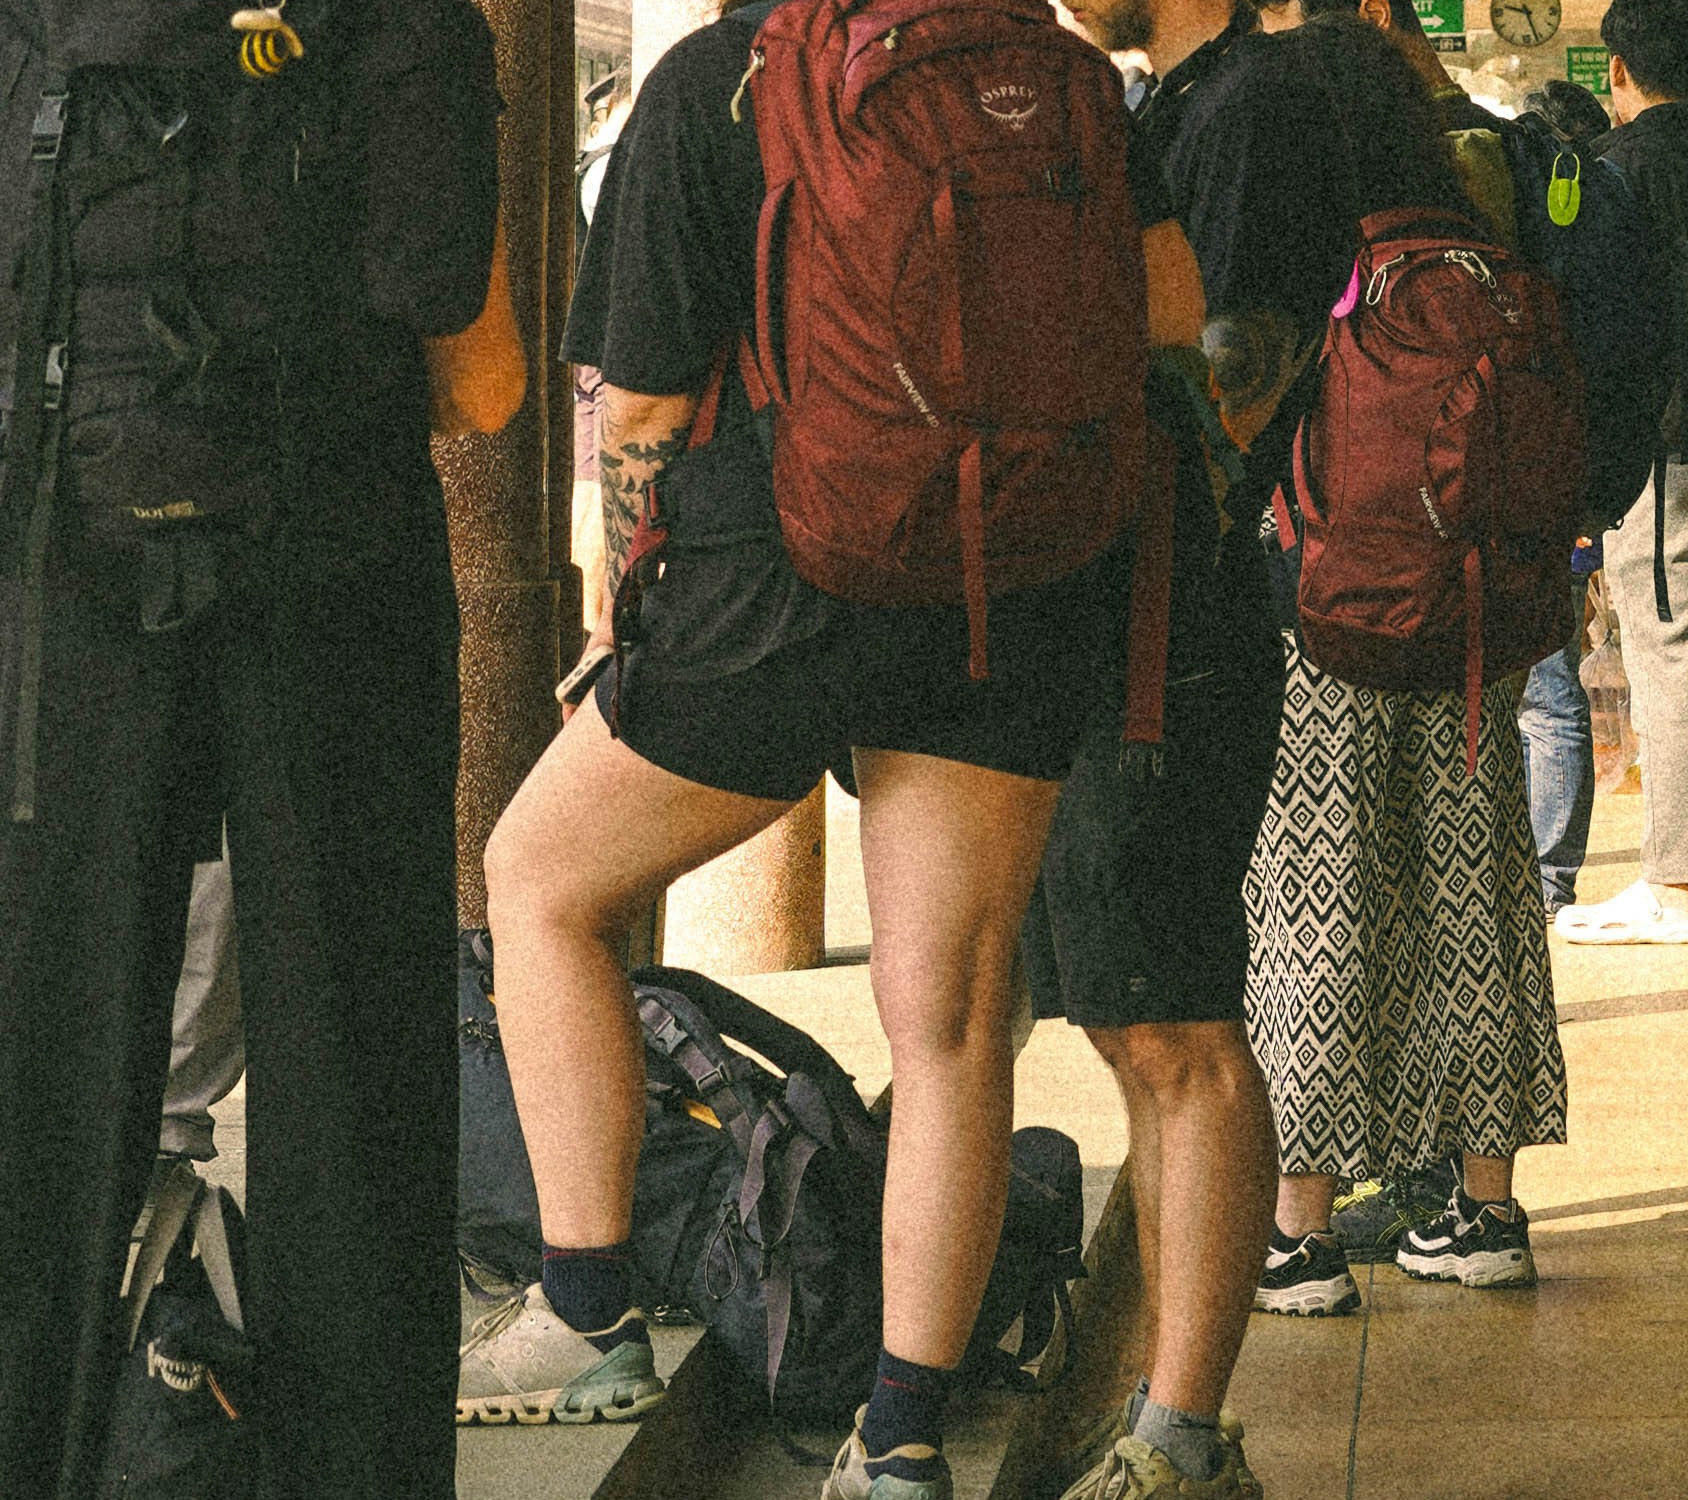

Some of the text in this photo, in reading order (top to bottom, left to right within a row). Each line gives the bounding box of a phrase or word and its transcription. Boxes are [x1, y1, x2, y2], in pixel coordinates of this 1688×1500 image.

[1413, 0, 1434, 12] XIT
[980, 85, 1035, 103] OSPREY
[893, 362, 930, 413] FAIRVIEW
[1418, 487, 1442, 528] FAIRVIEW
